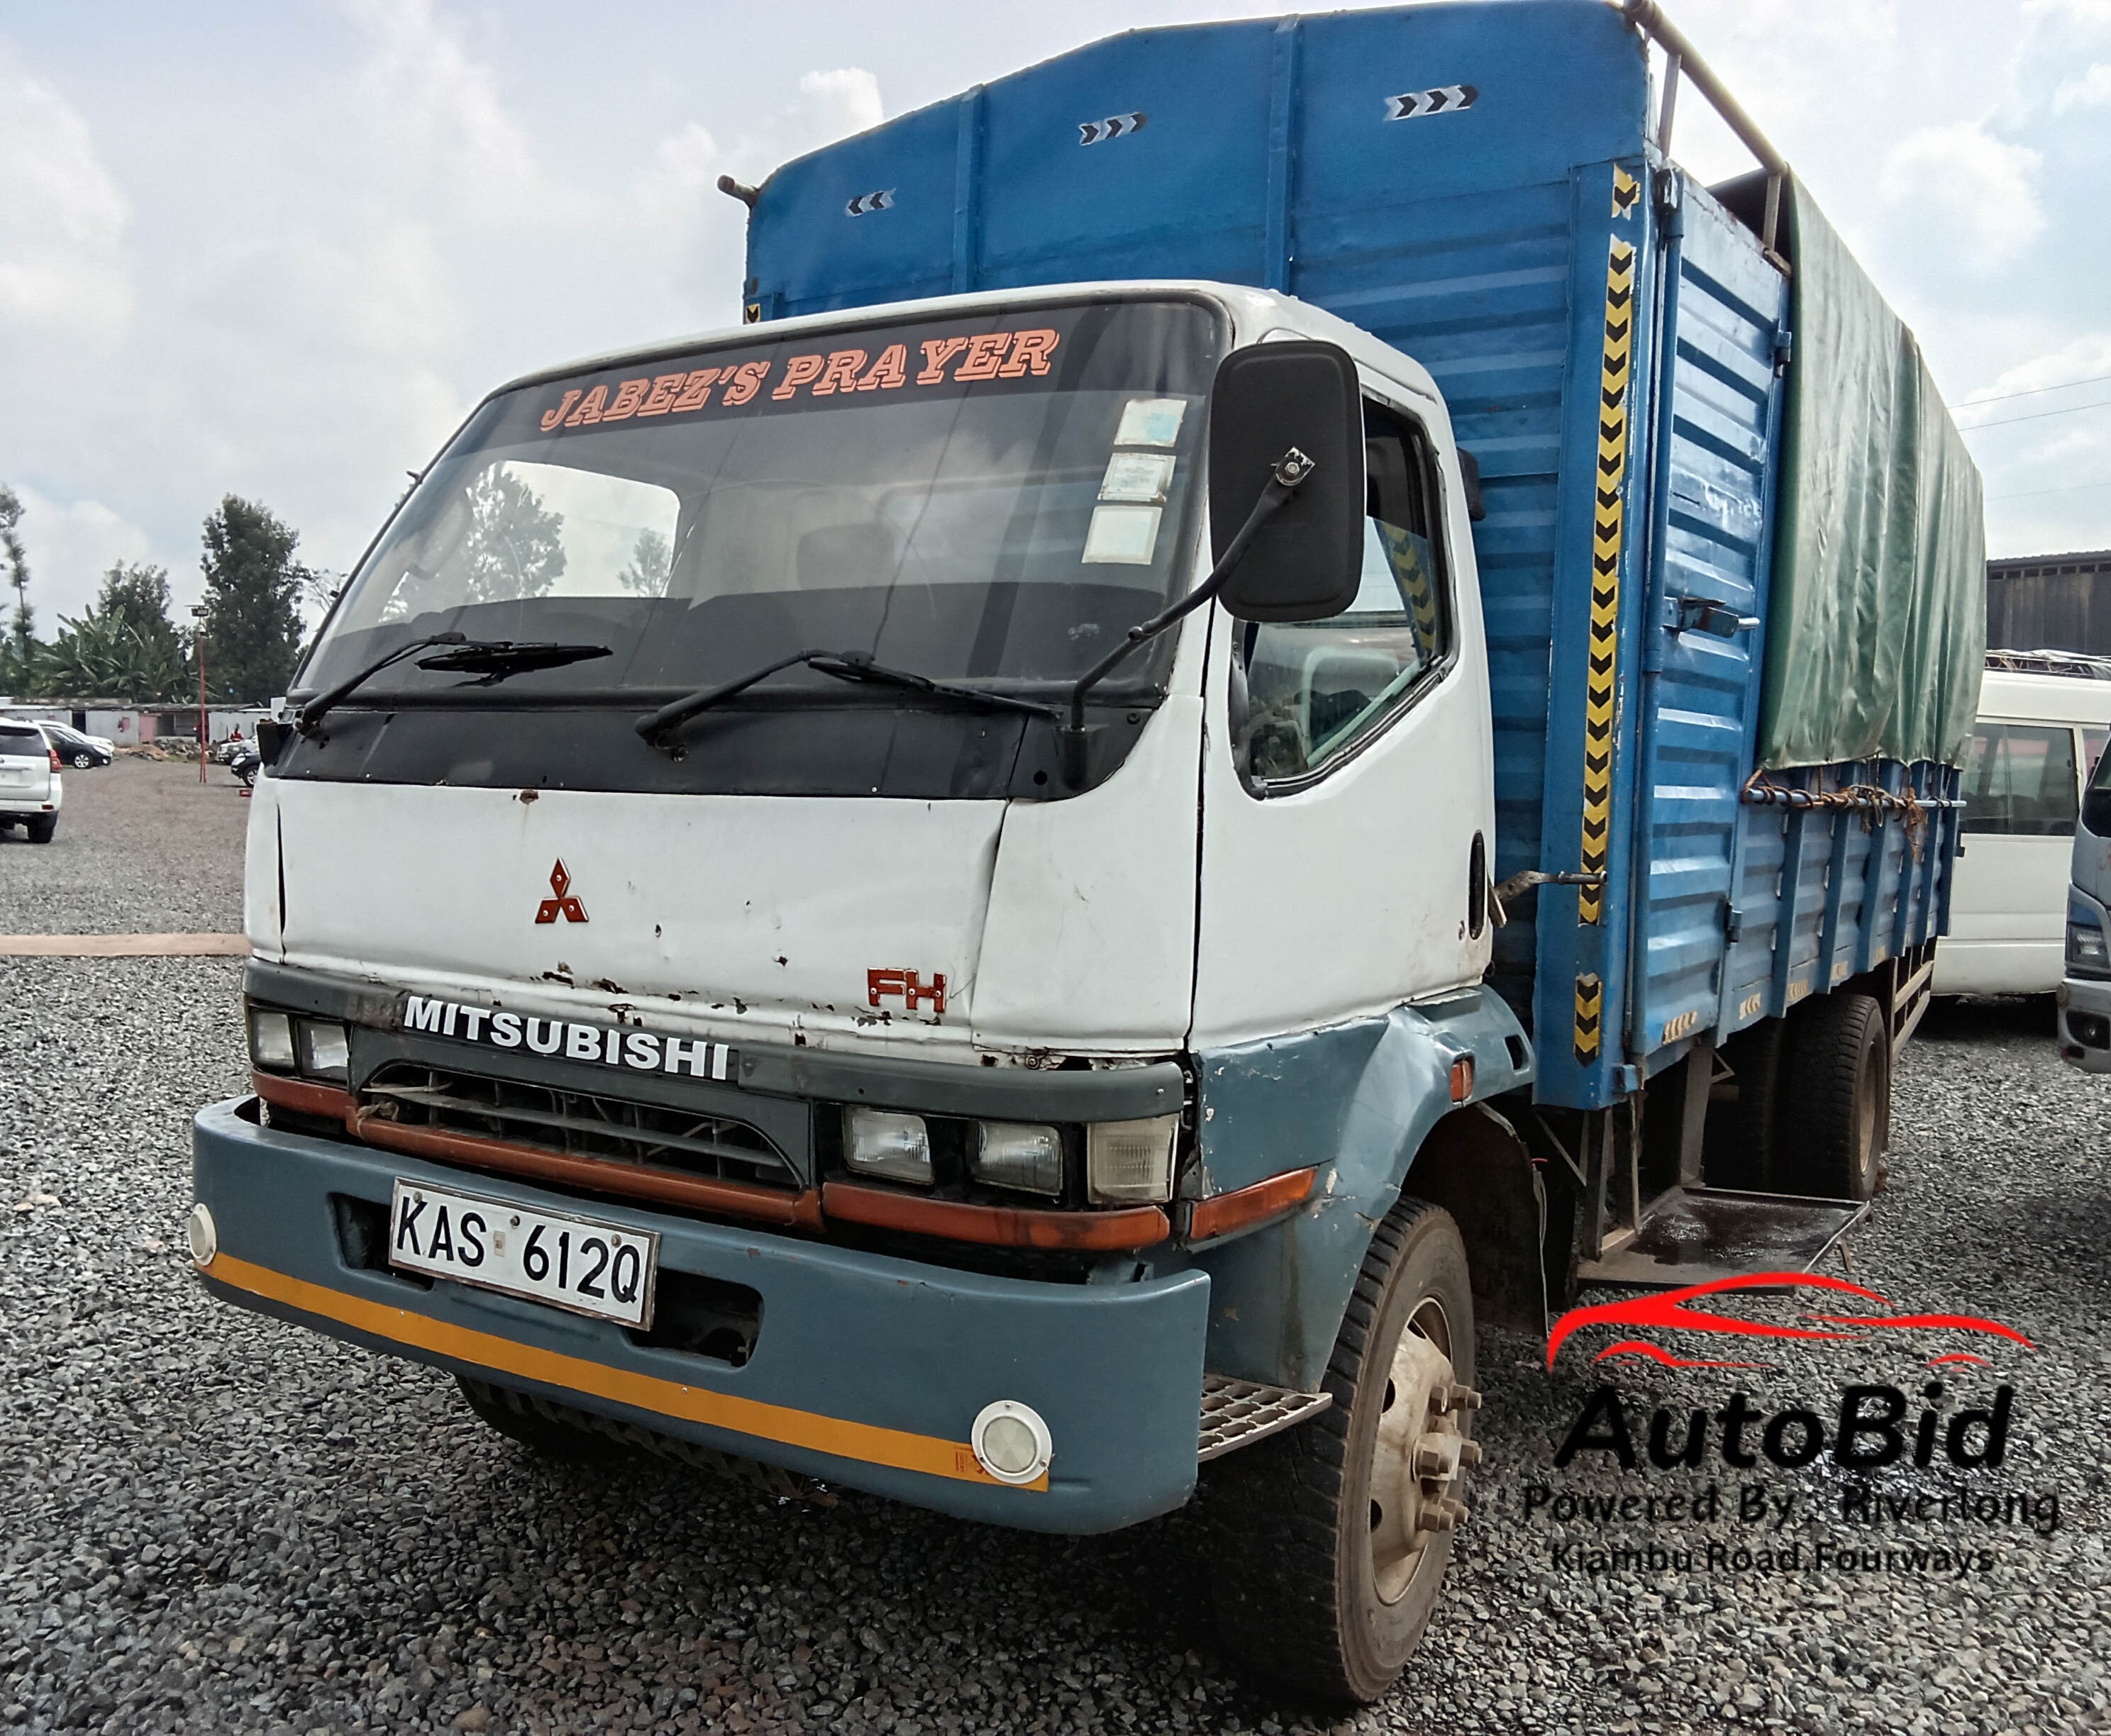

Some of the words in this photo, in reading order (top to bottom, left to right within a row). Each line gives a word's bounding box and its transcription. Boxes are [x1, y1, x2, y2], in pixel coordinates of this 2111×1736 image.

[540, 360, 772, 432] JABEZ'S
[772, 328, 1060, 401] PRAYER
[403, 995, 730, 1081] MITSUBISHI
[867, 967, 947, 1014] FH
[396, 1196, 487, 1269] KAS
[522, 1223, 641, 1304] 612Q
